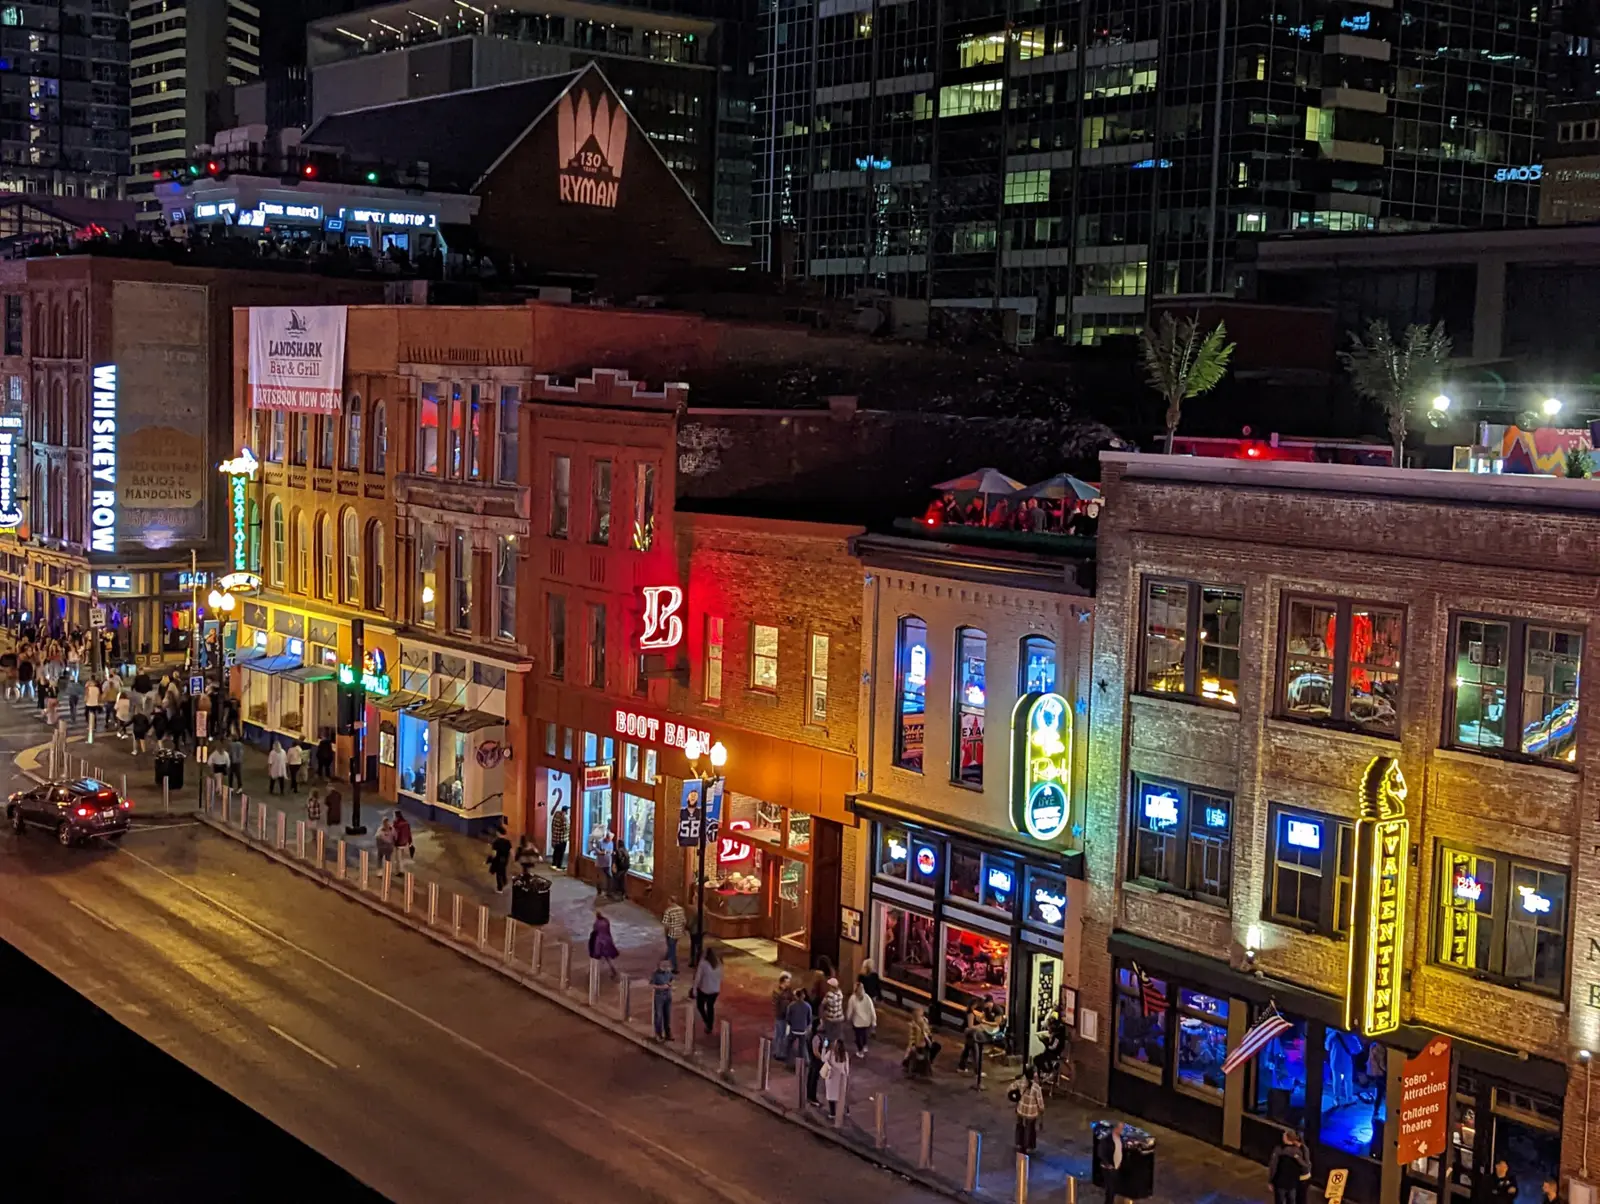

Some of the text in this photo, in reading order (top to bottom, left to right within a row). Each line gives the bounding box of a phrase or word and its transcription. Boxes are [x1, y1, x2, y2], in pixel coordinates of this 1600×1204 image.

[580, 152, 602, 167] 130
[560, 174, 619, 208] RYMAN
[389, 213, 425, 226] ROOFTOP
[269, 340, 323, 357] LANDSHARK
[270, 361, 320, 376] Bar & Grill
[299, 391, 318, 408] NOW
[320, 392, 341, 409] OPEN
[92, 364, 117, 483] WHISKEY
[131, 475, 176, 487] BANJOS
[125, 488, 192, 500] MANDOLINS
[92, 490, 116, 552] ROW
[640, 586, 683, 649] B
[616, 710, 659, 741] BOOT
[680, 820, 701, 838] 58
[1375, 835, 1400, 1031] VALENTINE
[1404, 1073, 1428, 1088] SoBro
[1404, 1081, 1448, 1101] Attractions
[1402, 1103, 1439, 1121] Childrens
[1402, 1118, 1432, 1135] Theatre
